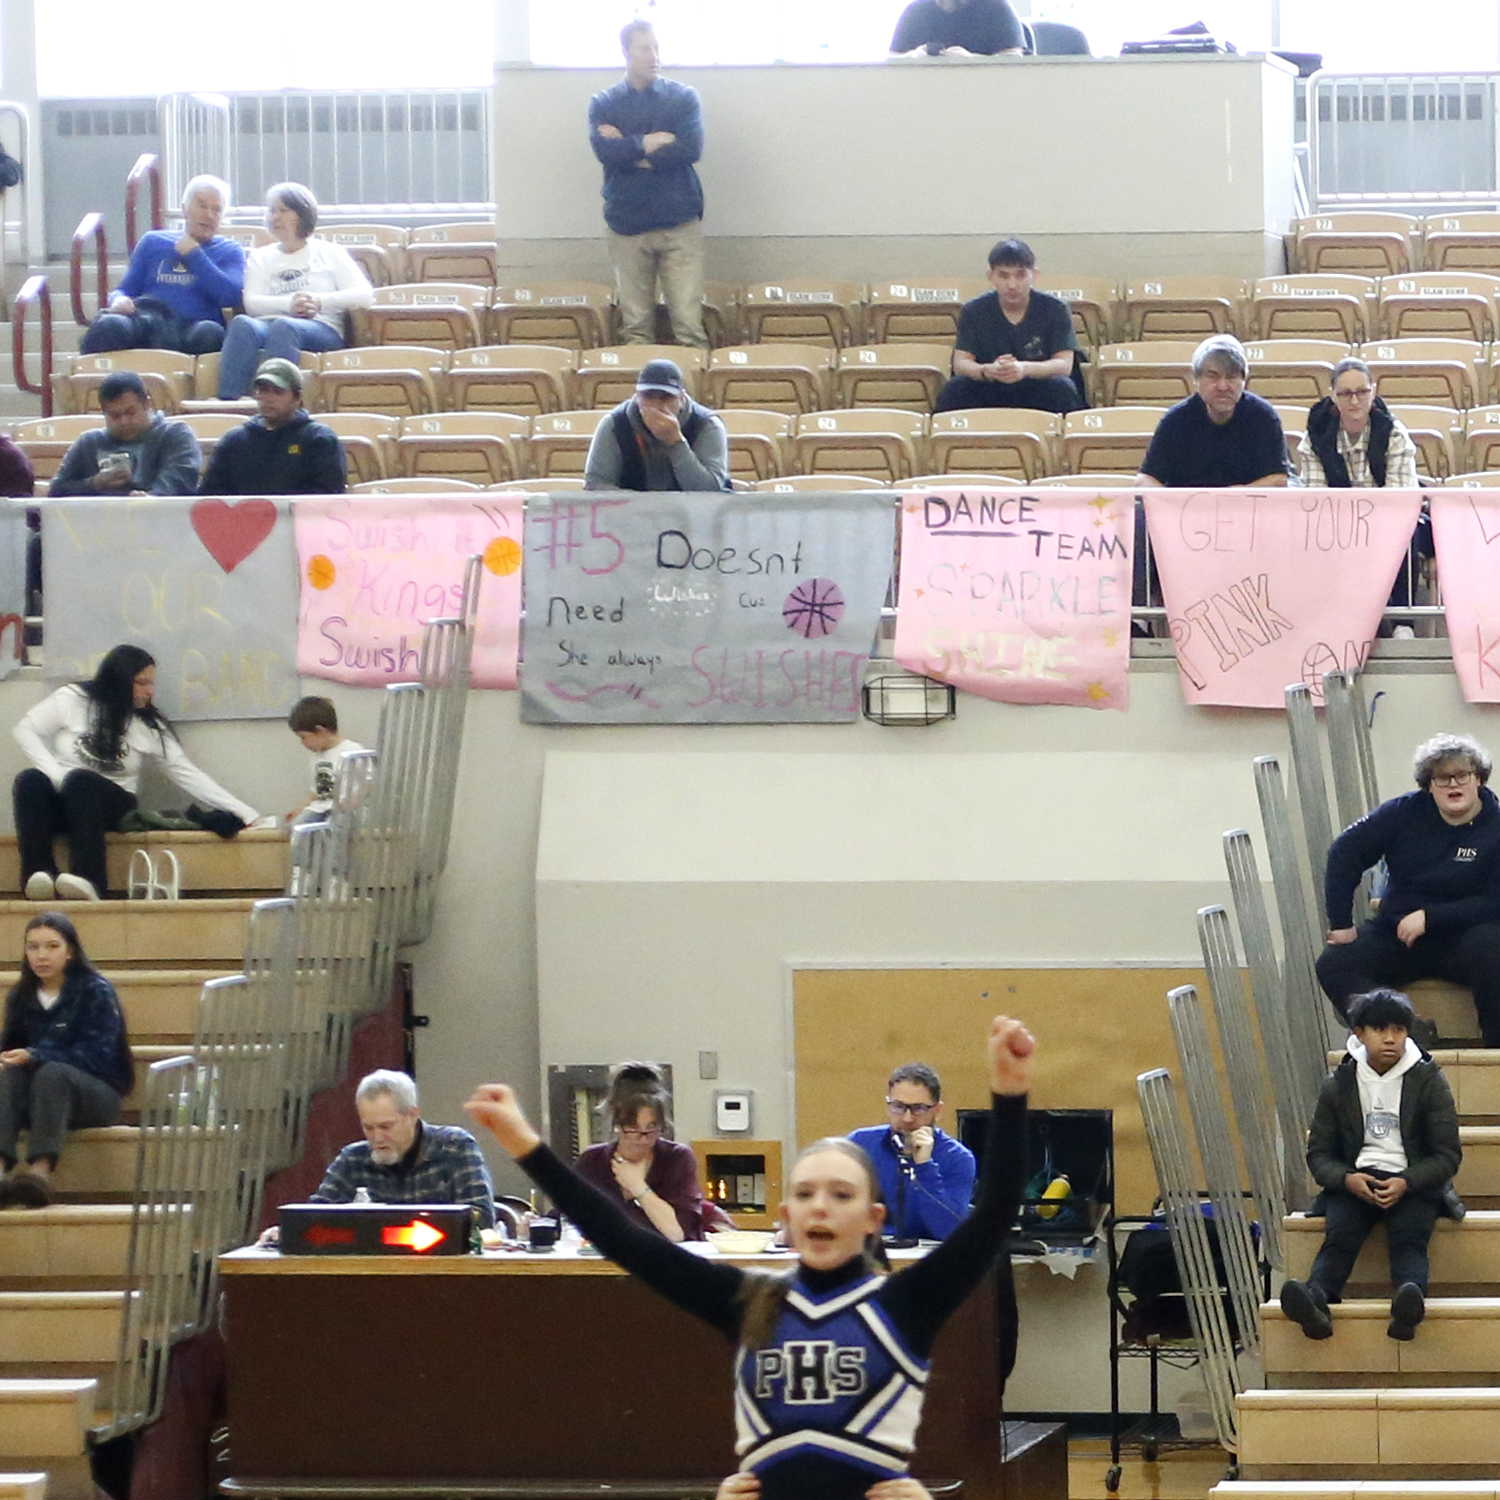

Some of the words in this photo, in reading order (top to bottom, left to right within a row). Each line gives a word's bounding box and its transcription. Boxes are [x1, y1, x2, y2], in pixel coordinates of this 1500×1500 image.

[533, 500, 630, 575] #5
[924, 492, 1043, 528] DANCE
[1180, 491, 1268, 552] GET
[1300, 496, 1375, 551] YOUR
[1028, 530, 1129, 561] TEAM
[355, 560, 466, 625] Kings
[927, 563, 1121, 619] SPARKLE
[319, 616, 423, 672] Swish
[558, 640, 588, 667] She
[608, 650, 663, 675] always
[924, 628, 1077, 681] SHINE
[1167, 573, 1294, 691] PINK
[755, 1340, 868, 1405] PHS
